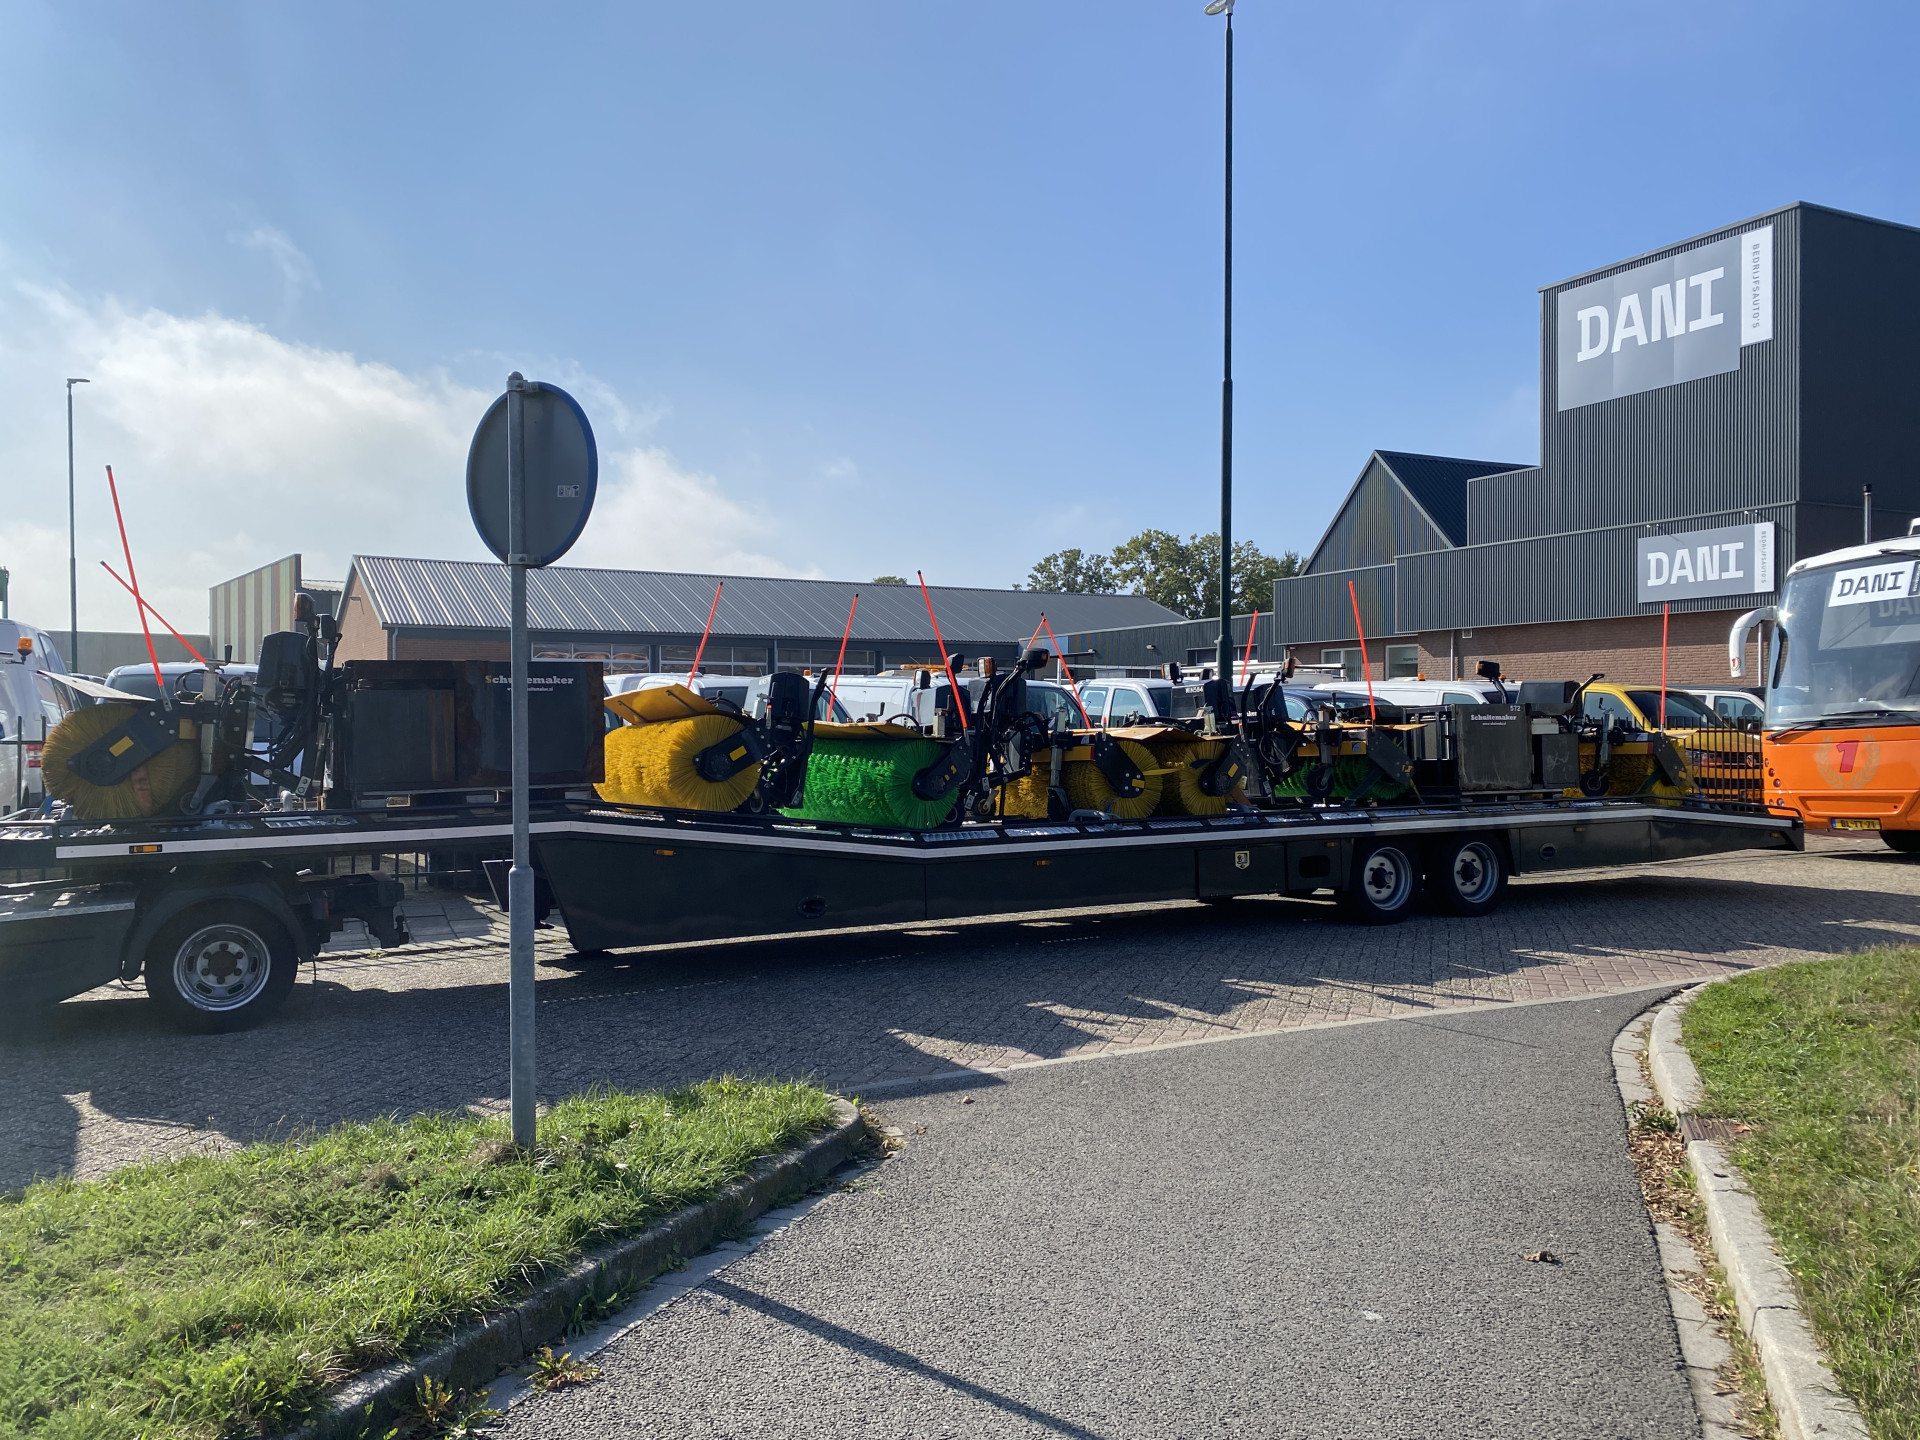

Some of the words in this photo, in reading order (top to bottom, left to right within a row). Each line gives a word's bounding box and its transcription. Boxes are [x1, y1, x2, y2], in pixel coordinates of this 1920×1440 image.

[1752, 243, 1761, 329] BEDRIJFSAUTO'S
[1577, 266, 1725, 363] DANI
[1647, 542, 1744, 587] DANI
[1837, 570, 1905, 597] DANI
[1836, 740, 1859, 773] 1
